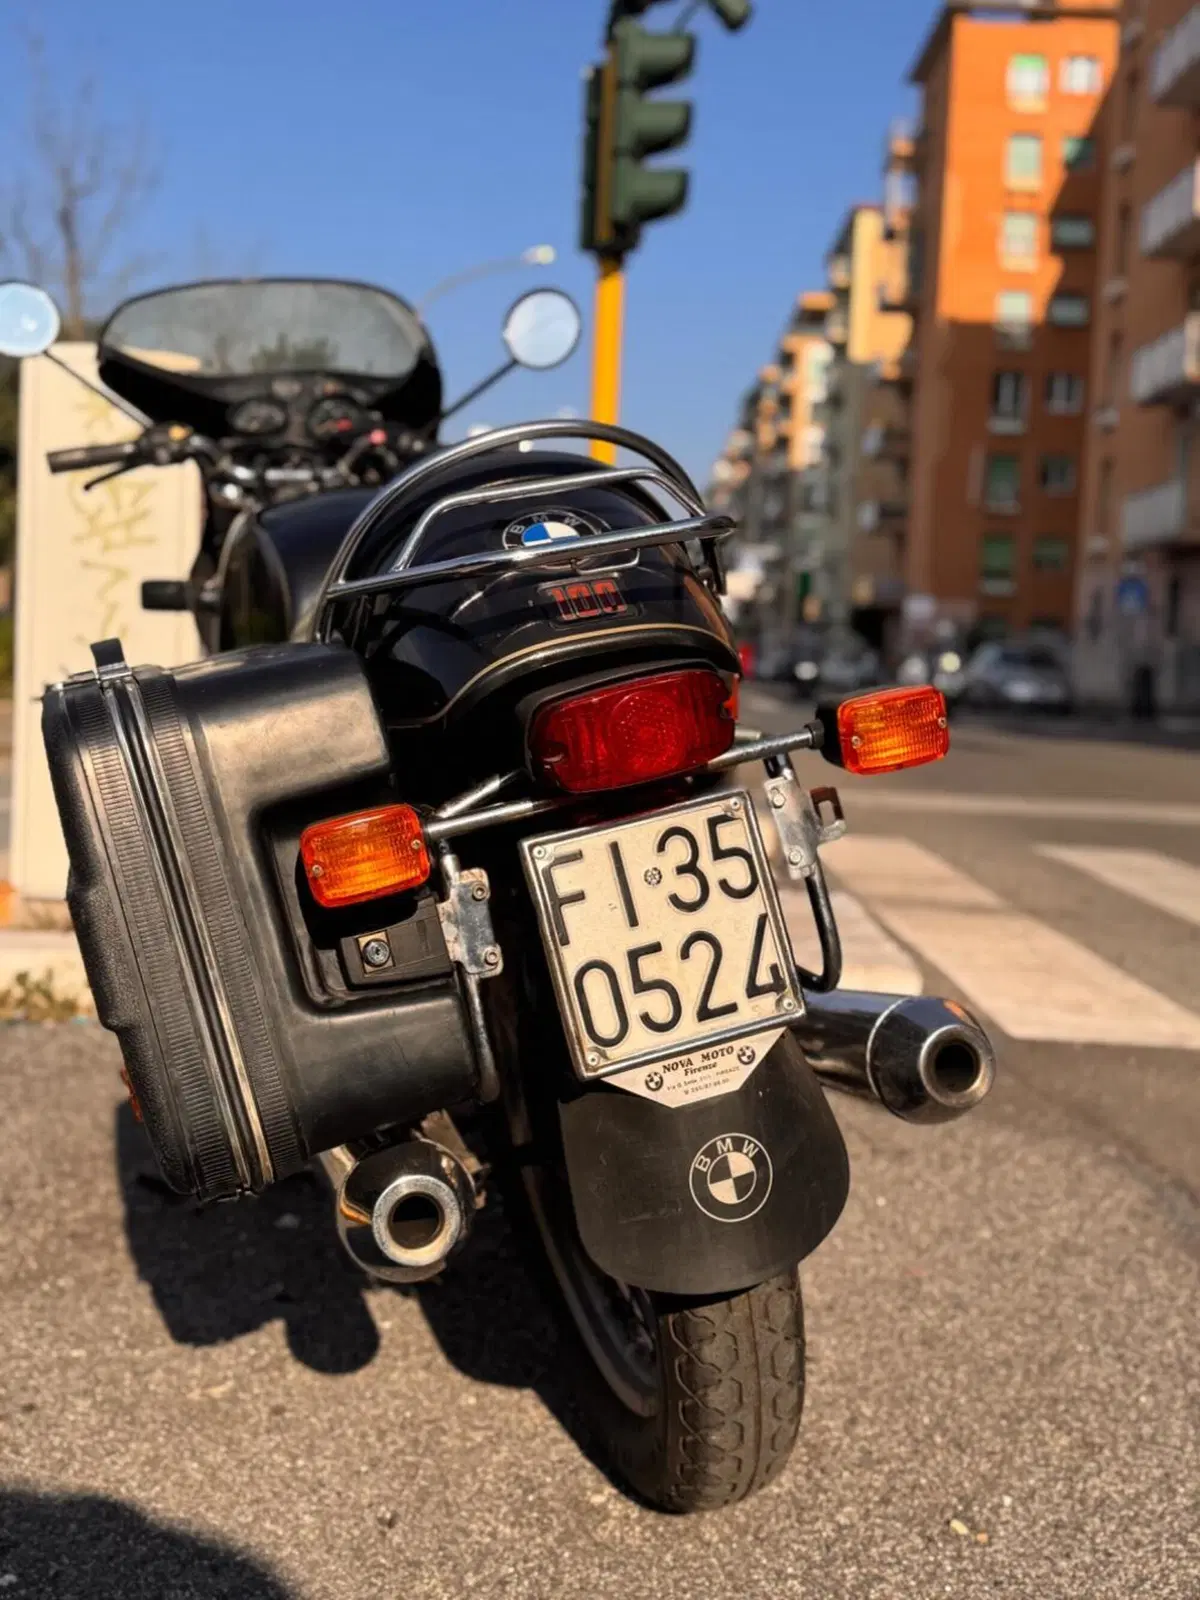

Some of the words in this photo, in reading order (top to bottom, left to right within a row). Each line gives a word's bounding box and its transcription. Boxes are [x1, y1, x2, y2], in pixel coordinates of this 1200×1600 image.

[510, 514, 581, 534] BMW
[541, 840, 639, 947] FI
[656, 813, 760, 913] 35
[573, 912, 787, 1048] 0524
[662, 1057, 694, 1074] NOVA
[701, 1045, 735, 1063] MOTO
[684, 1061, 718, 1077] Firenze
[695, 1137, 759, 1172] BMW
